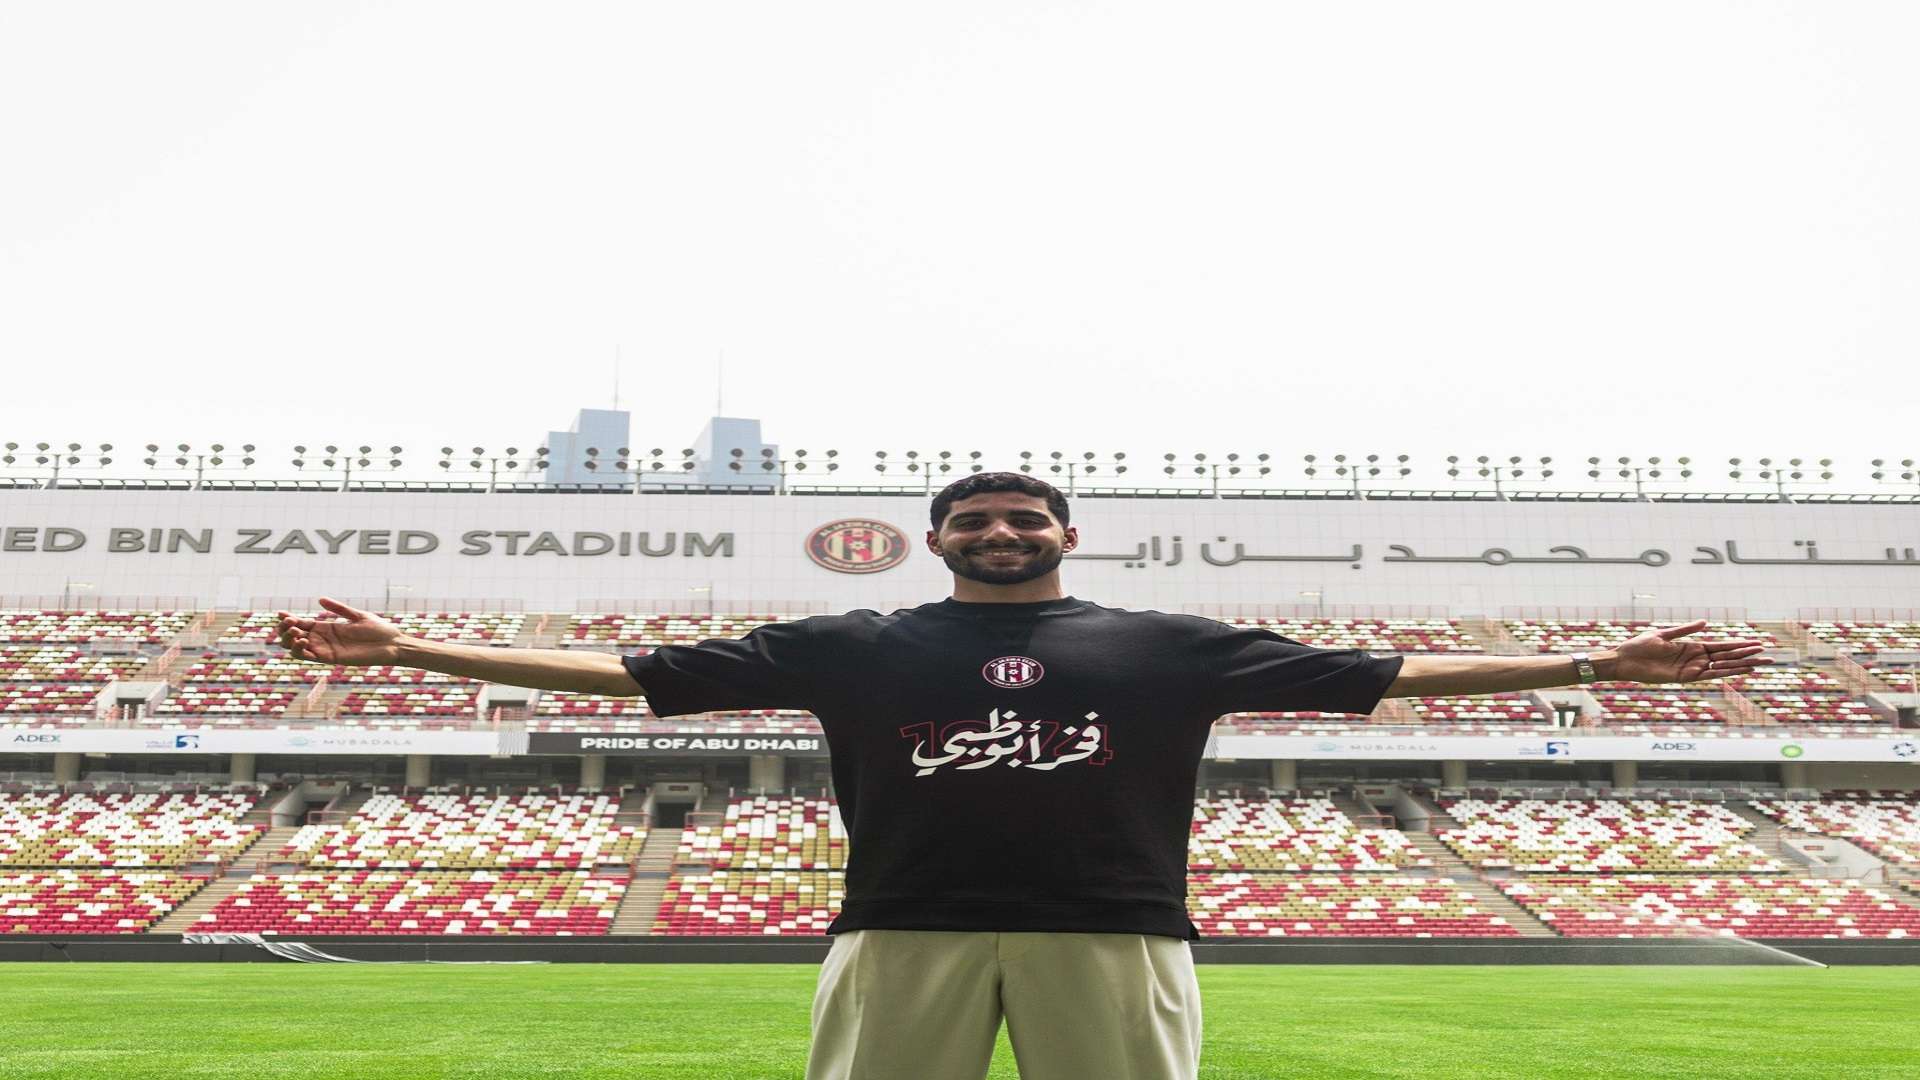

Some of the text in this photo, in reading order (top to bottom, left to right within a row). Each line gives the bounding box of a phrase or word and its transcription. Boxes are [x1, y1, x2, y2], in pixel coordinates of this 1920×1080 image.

[0, 527, 735, 557] ED BIN ZAYED STADIUM
[1063, 536, 1182, 568] زاي
[1200, 536, 1363, 569] بن
[1383, 545, 1671, 567] محمد
[14, 735, 61, 743] ADEX
[580, 737, 819, 750] PRIDE OF ABU DHABI
[1024, 711, 1101, 771] فخر
[1651, 742, 1697, 751] ADEX
